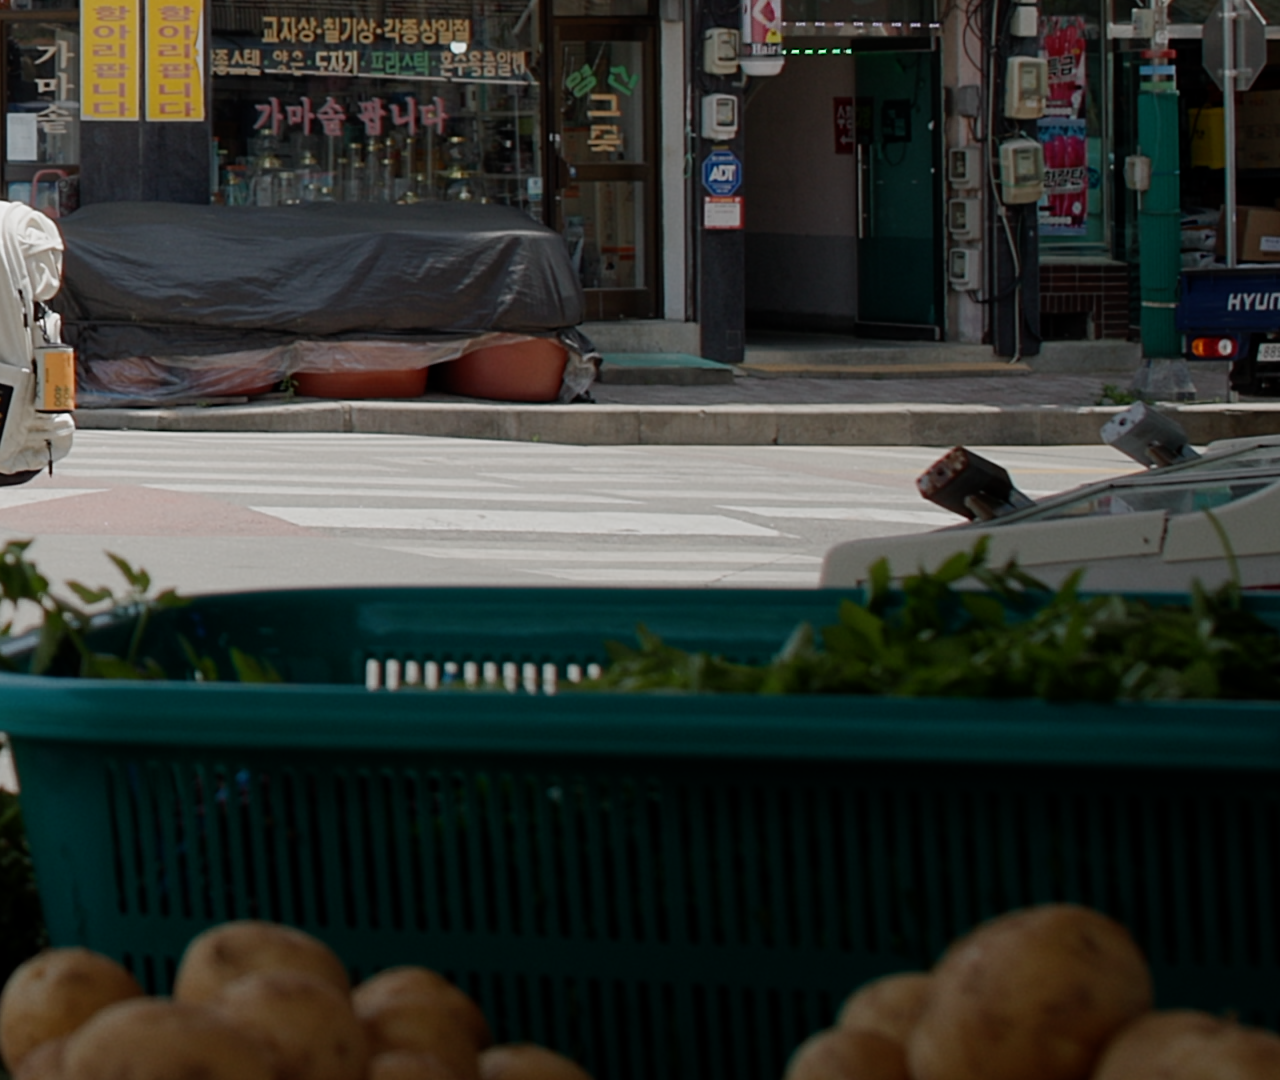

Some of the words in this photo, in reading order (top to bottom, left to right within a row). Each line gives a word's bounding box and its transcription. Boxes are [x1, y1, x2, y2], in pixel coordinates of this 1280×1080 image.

[33, 39, 74, 133] 가마솥
[92, 5, 130, 118] 항아리팝니다
[156, 5, 196, 118] 항아리팝니다
[315, 51, 358, 75] 도자기
[370, 51, 428, 75] 프라스틱
[565, 62, 638, 98] 영신
[253, 97, 347, 137] 가마솥
[357, 97, 450, 136] 팝니다
[586, 93, 621, 152] 그릇
[708, 164, 736, 182] ADT
